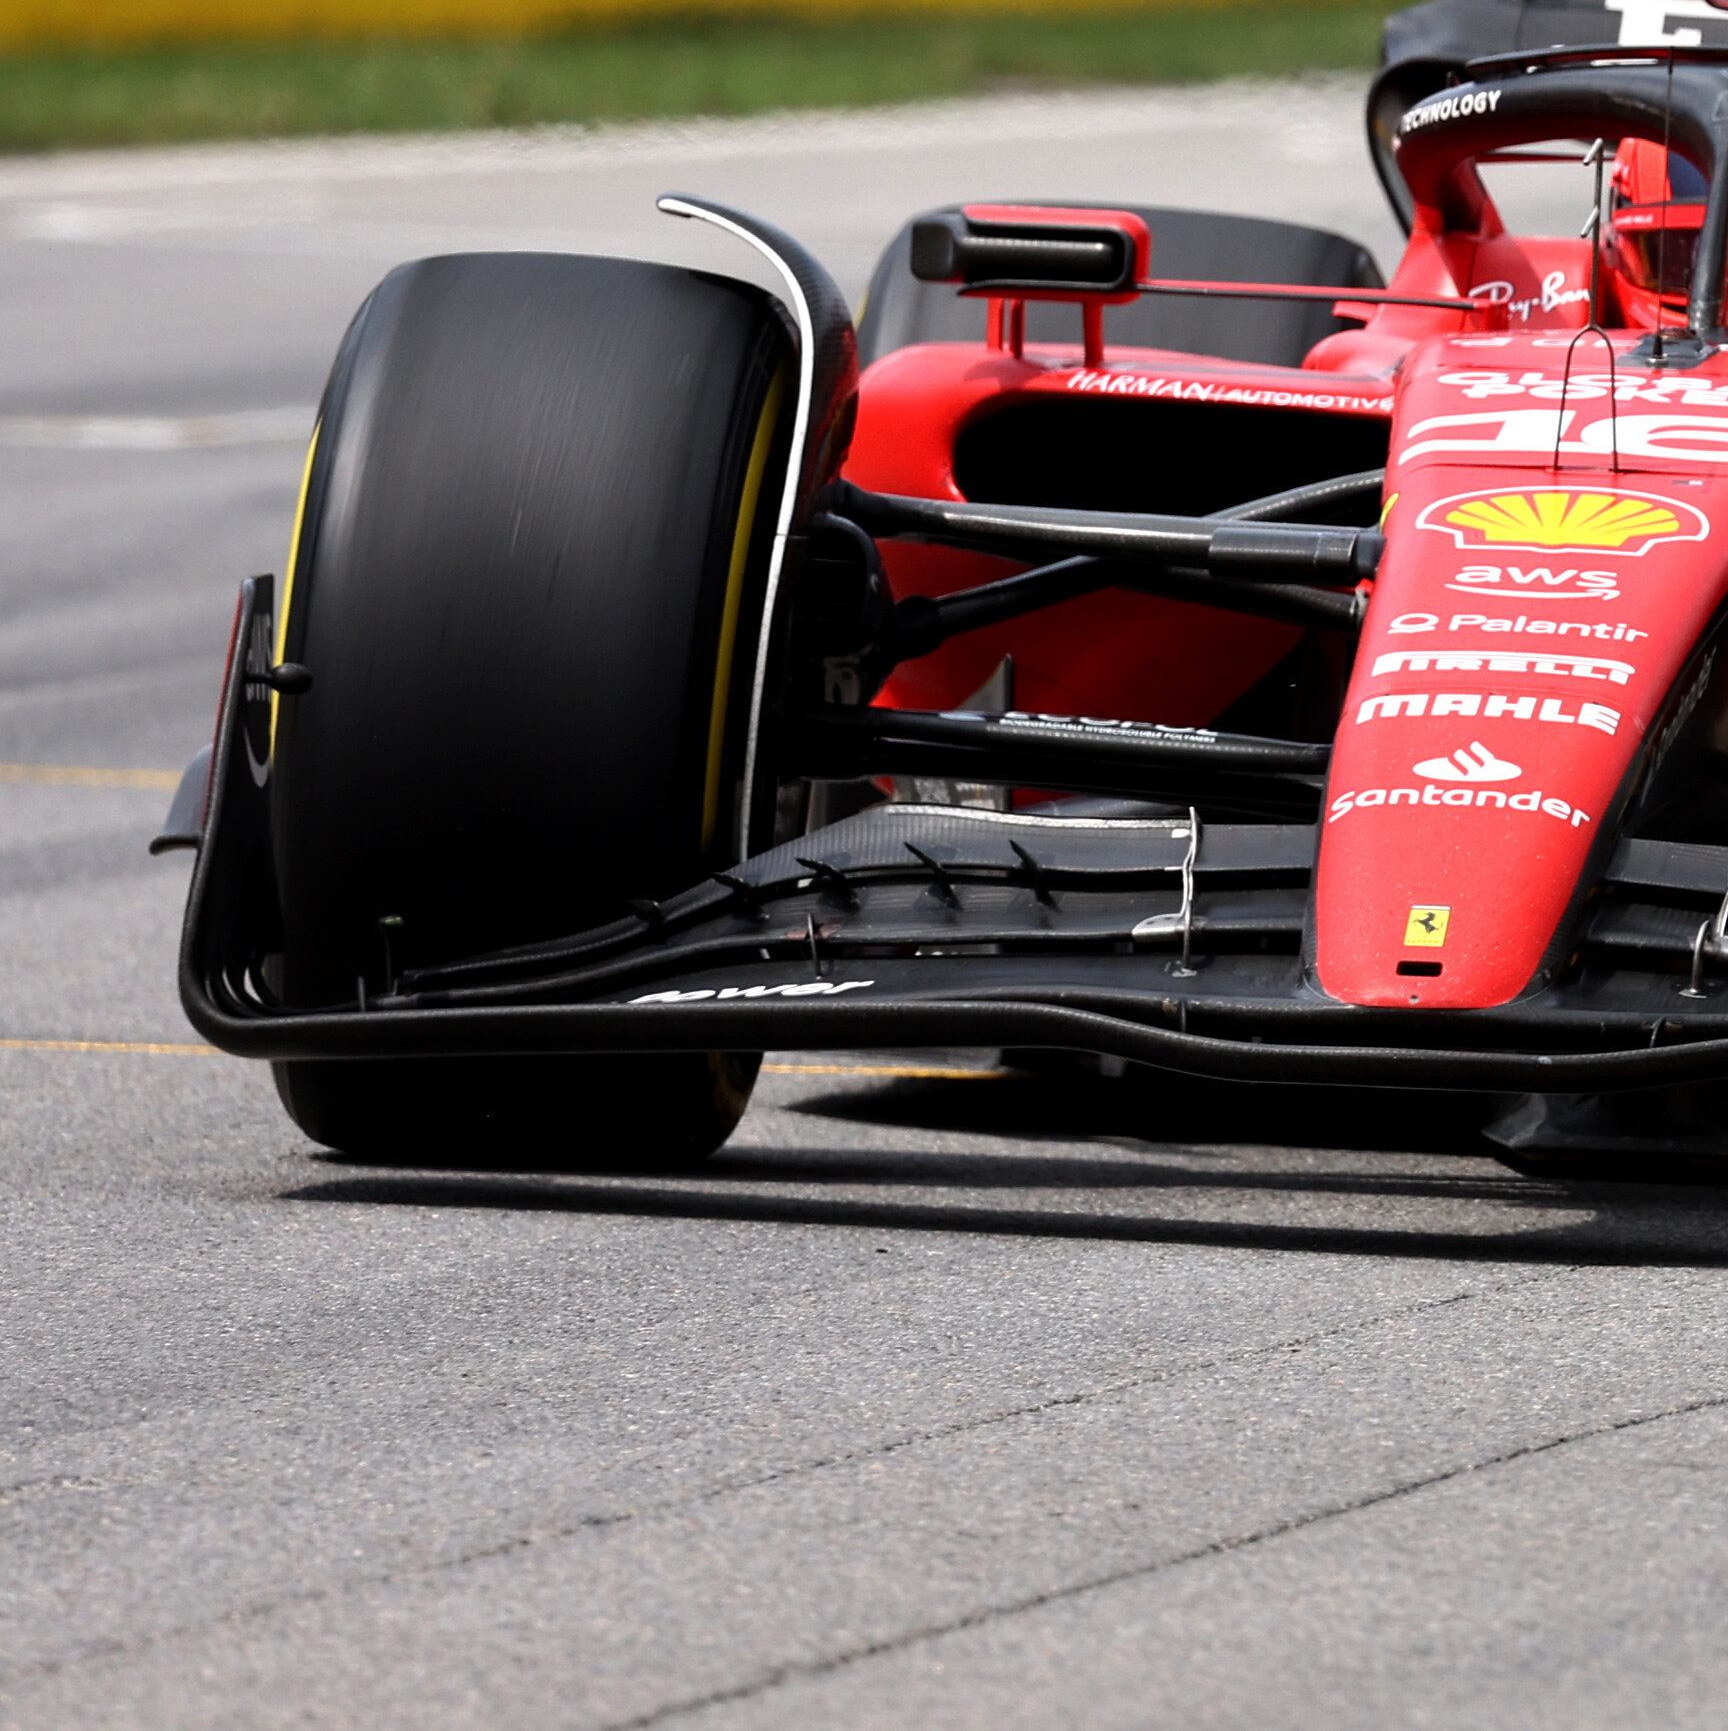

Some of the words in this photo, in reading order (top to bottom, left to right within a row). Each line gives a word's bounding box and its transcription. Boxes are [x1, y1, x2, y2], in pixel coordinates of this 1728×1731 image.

[1067, 370, 1209, 401] HARMAN
[1222, 388, 1395, 411] AUTOMOTIVE
[1455, 565, 1618, 588] aws
[1448, 615, 1649, 643] Palantir
[1371, 650, 1636, 686] PIRELLI
[1355, 693, 1622, 736] MAHLE
[1328, 784, 1591, 827] Santander
